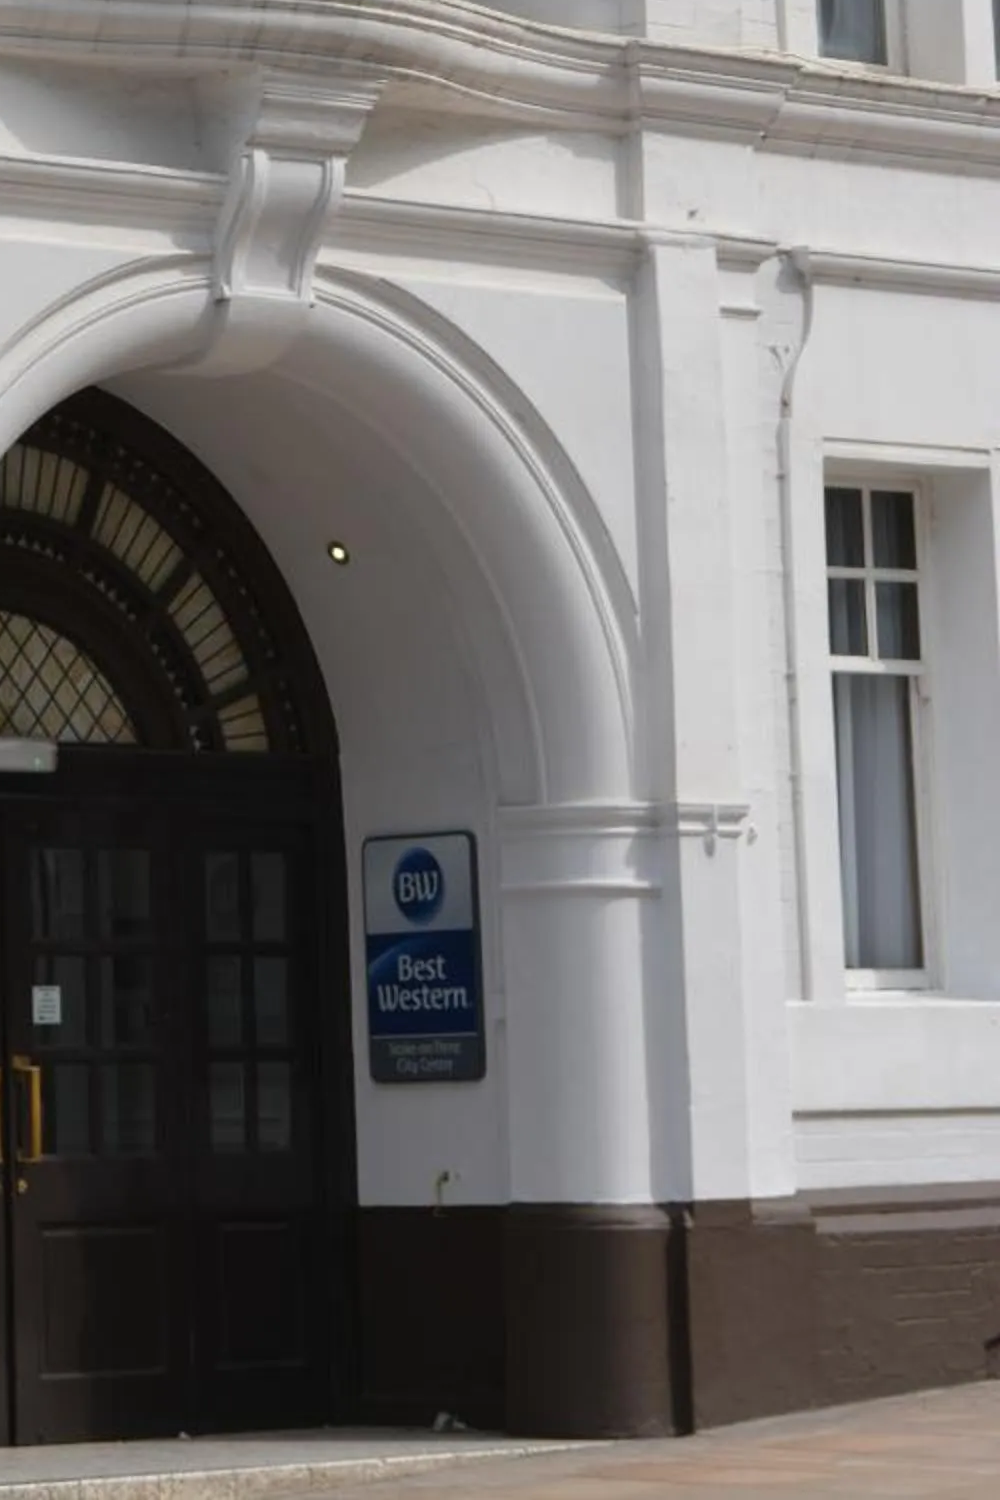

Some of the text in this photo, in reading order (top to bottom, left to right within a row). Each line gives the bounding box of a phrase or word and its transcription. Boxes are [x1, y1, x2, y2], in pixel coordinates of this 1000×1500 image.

[400, 871, 439, 902] BW
[397, 954, 447, 981] Best
[377, 983, 468, 1011] Western
